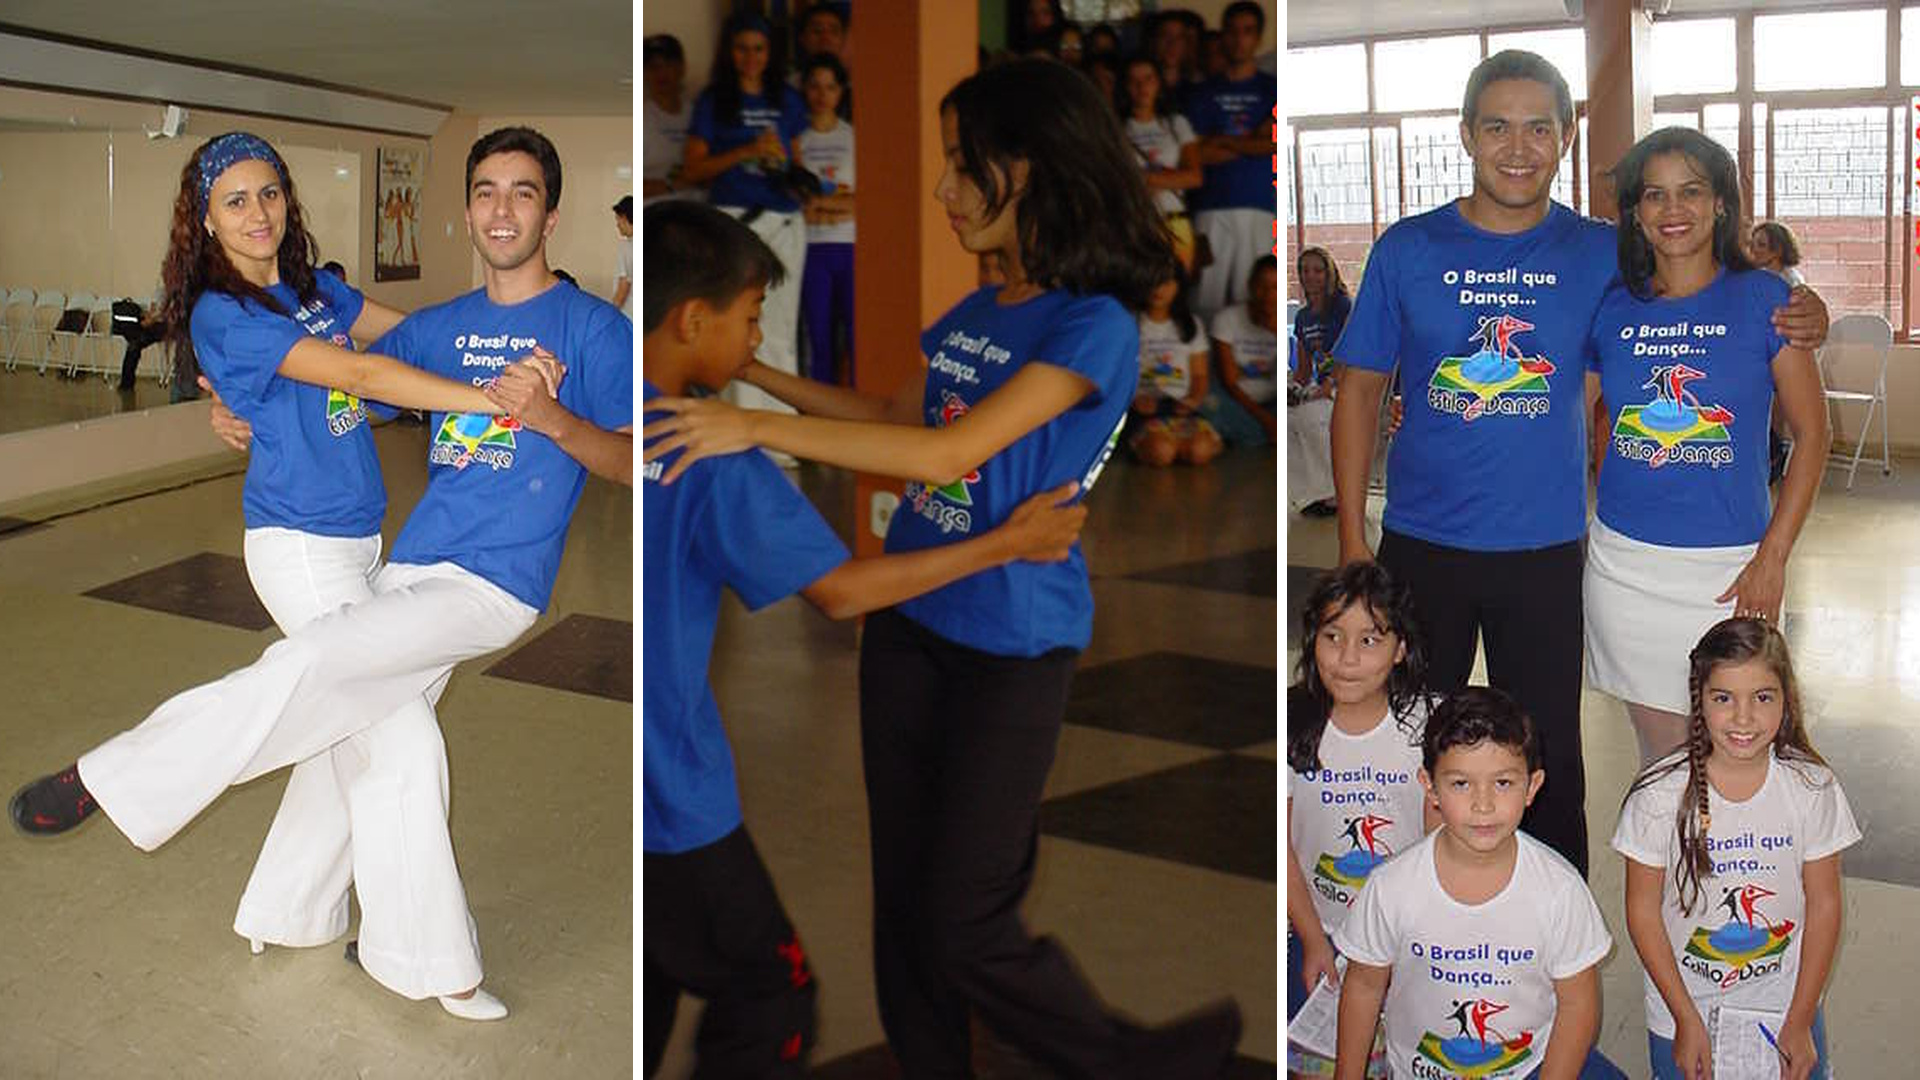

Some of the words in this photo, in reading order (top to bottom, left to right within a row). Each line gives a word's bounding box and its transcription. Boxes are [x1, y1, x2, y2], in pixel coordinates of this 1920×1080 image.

[1443, 270, 1459, 285] O
[1464, 268, 1517, 285] Brasil
[1522, 273, 1557, 288] que
[1459, 289, 1537, 308] Dança...
[1620, 326, 1634, 339] O
[1638, 322, 1688, 338] Brasil
[1692, 324, 1727, 338] que
[455, 336, 466, 349] O
[468, 334, 508, 348] Brasil
[509, 337, 537, 351] que
[1632, 341, 1707, 358] Dança...
[983, 344, 1011, 364] que
[1303, 768, 1317, 783] O
[1321, 766, 1372, 784] Brasil
[1375, 772, 1408, 786] que
[1706, 833, 1755, 851] Brasil
[1760, 835, 1794, 851] que
[1411, 942, 1425, 957] O
[1430, 944, 1490, 961] Brasil
[1496, 948, 1535, 966] que
[1430, 965, 1513, 988] Dança...
